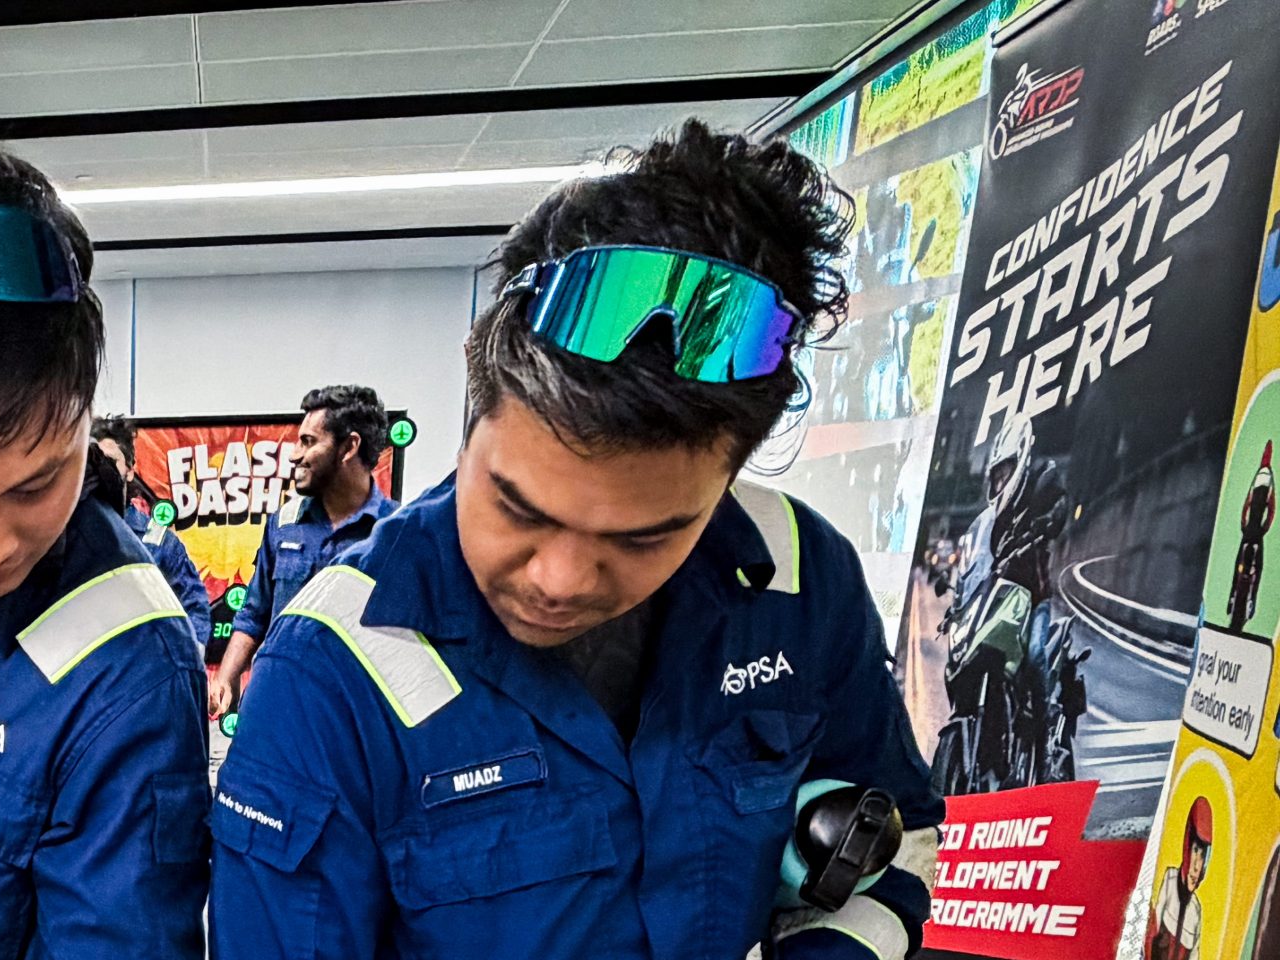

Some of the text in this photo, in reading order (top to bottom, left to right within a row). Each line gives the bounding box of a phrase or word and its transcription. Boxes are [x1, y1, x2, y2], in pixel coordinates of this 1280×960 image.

[985, 60, 1233, 291] CONFIDENCE
[950, 110, 1243, 387] STARTS
[974, 256, 1172, 447] HERE
[172, 477, 283, 520] DASH
[214, 623, 232, 638] 30
[747, 651, 795, 690] PSA
[1215, 659, 1242, 685] your
[1229, 705, 1255, 741] early
[453, 765, 503, 792] MUADZ
[243, 805, 284, 832] Network
[968, 816, 1053, 850] RIDING
[933, 860, 1061, 891] LOPMENT
[931, 899, 1086, 937] ROGRAMME
